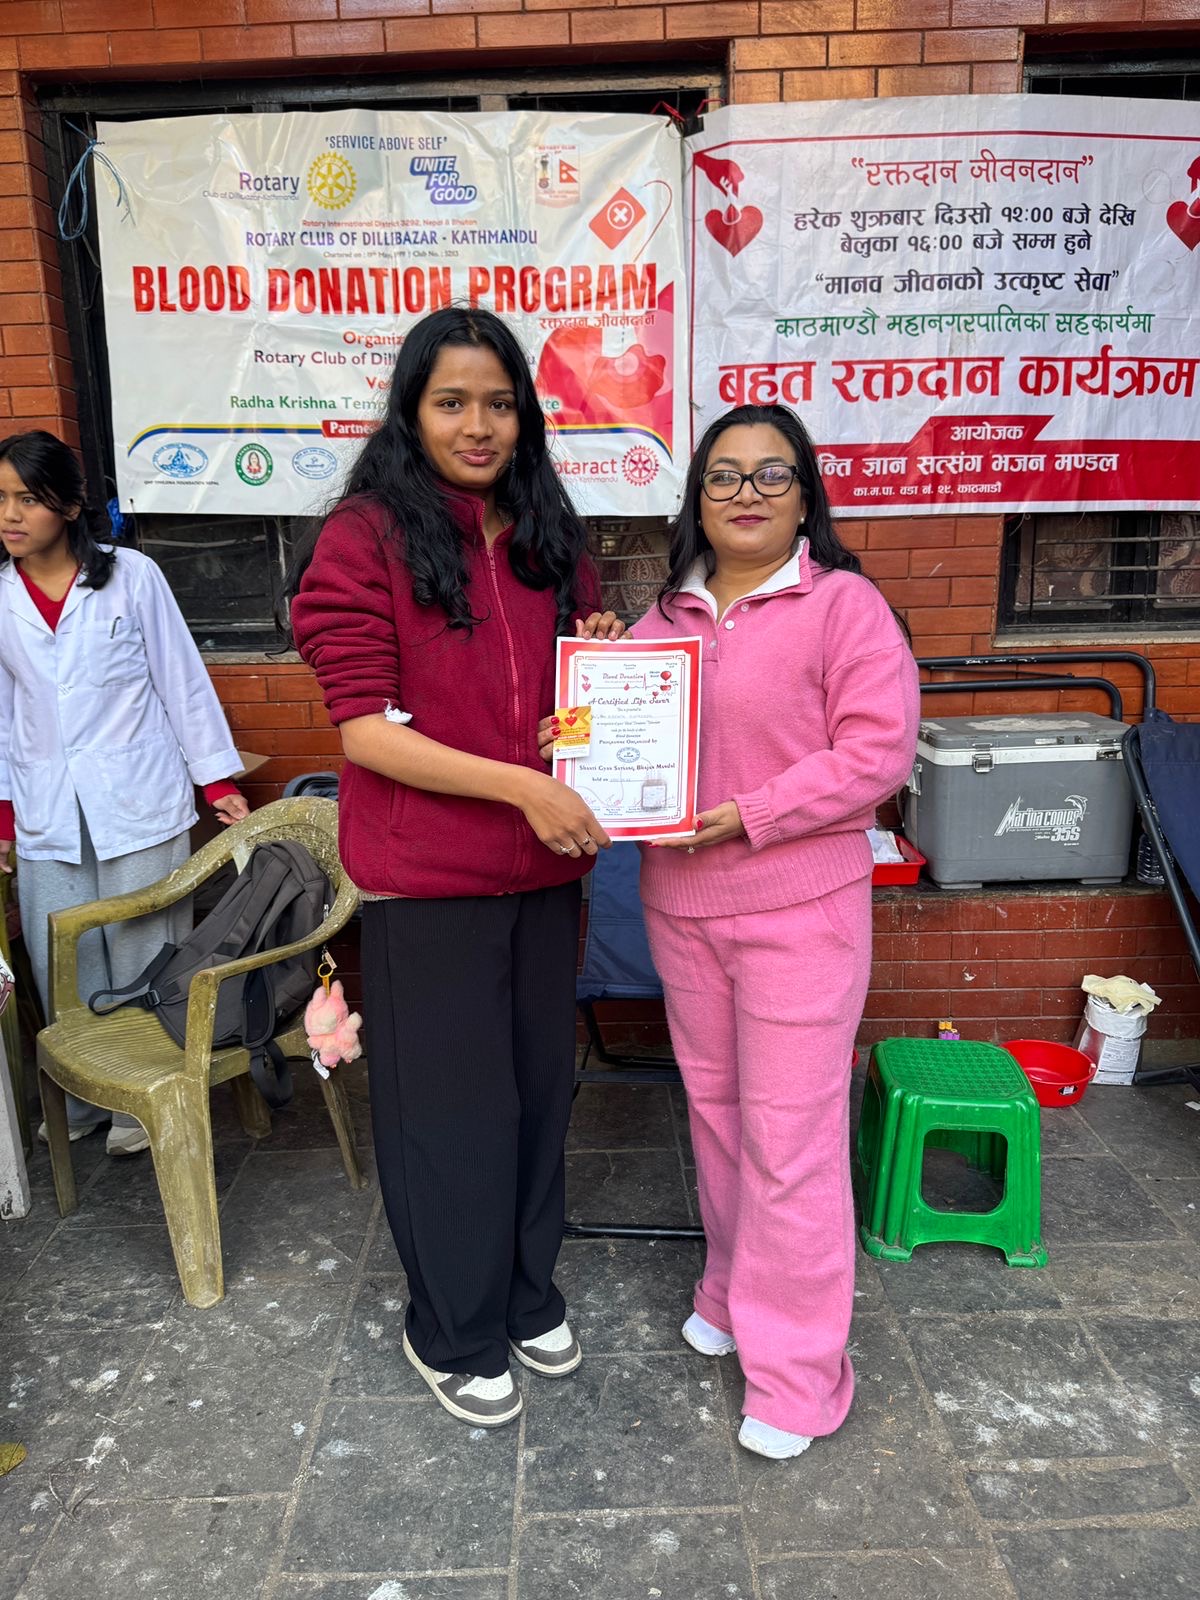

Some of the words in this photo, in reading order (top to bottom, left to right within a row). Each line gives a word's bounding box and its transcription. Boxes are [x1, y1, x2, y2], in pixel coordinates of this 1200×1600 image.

[378, 136, 415, 150] ABOVE
[413, 157, 456, 172] UNITE
[239, 172, 300, 194] Rotary
[430, 172, 458, 186] FOR
[434, 187, 476, 201] GOOD
[302, 219, 327, 228] Rotary
[328, 219, 373, 227] International
[375, 219, 400, 227] District
[794, 207, 842, 231] हरेक
[850, 208, 926, 233] शुक्रबार
[935, 202, 992, 226] दिउसो
[1062, 203, 1092, 226] बजे
[1099, 203, 1136, 226] देखि
[246, 232, 296, 246] ROTARY
[300, 231, 335, 246] CLUB
[340, 231, 358, 246] OF
[362, 230, 438, 246] DILLIBAZAR
[451, 229, 537, 245] KATHMANDU
[840, 232, 899, 259] बेलुका
[973, 228, 1004, 250] बजे
[1012, 232, 1057, 250] सम्म
[1063, 229, 1092, 255] हुने
[132, 265, 252, 313] BLOOD
[268, 266, 450, 314] DONATION
[469, 263, 657, 314] PROGRAM
[893, 266, 985, 294] जीवनको
[993, 271, 1064, 297] उत्कृष्ट
[538, 316, 588, 330] रक्तदान
[594, 313, 655, 328] जीवनदान
[886, 304, 1050, 335] महानगरपालिका
[1055, 305, 1155, 335] सहकार्यमा
[254, 350, 305, 367] Rotary
[311, 351, 347, 365] Club
[352, 351, 368, 365] of
[832, 355, 1004, 403] रक्तदान
[1018, 344, 1199, 399] कार्यक्रम
[230, 396, 275, 409] Radha
[279, 395, 337, 409] Krishna
[950, 421, 1025, 441] आयोजक
[553, 458, 618, 475] otaract
[861, 456, 908, 478] ज्ञान
[917, 451, 983, 475] सत्संग
[991, 453, 1047, 473] भजन
[1054, 453, 1120, 473] मण्डल
[900, 485, 918, 495] वडा
[597, 697, 629, 706] Certified
[631, 697, 647, 707] Life
[649, 696, 670, 705] Saver
[1051, 826, 1081, 841] 35S
